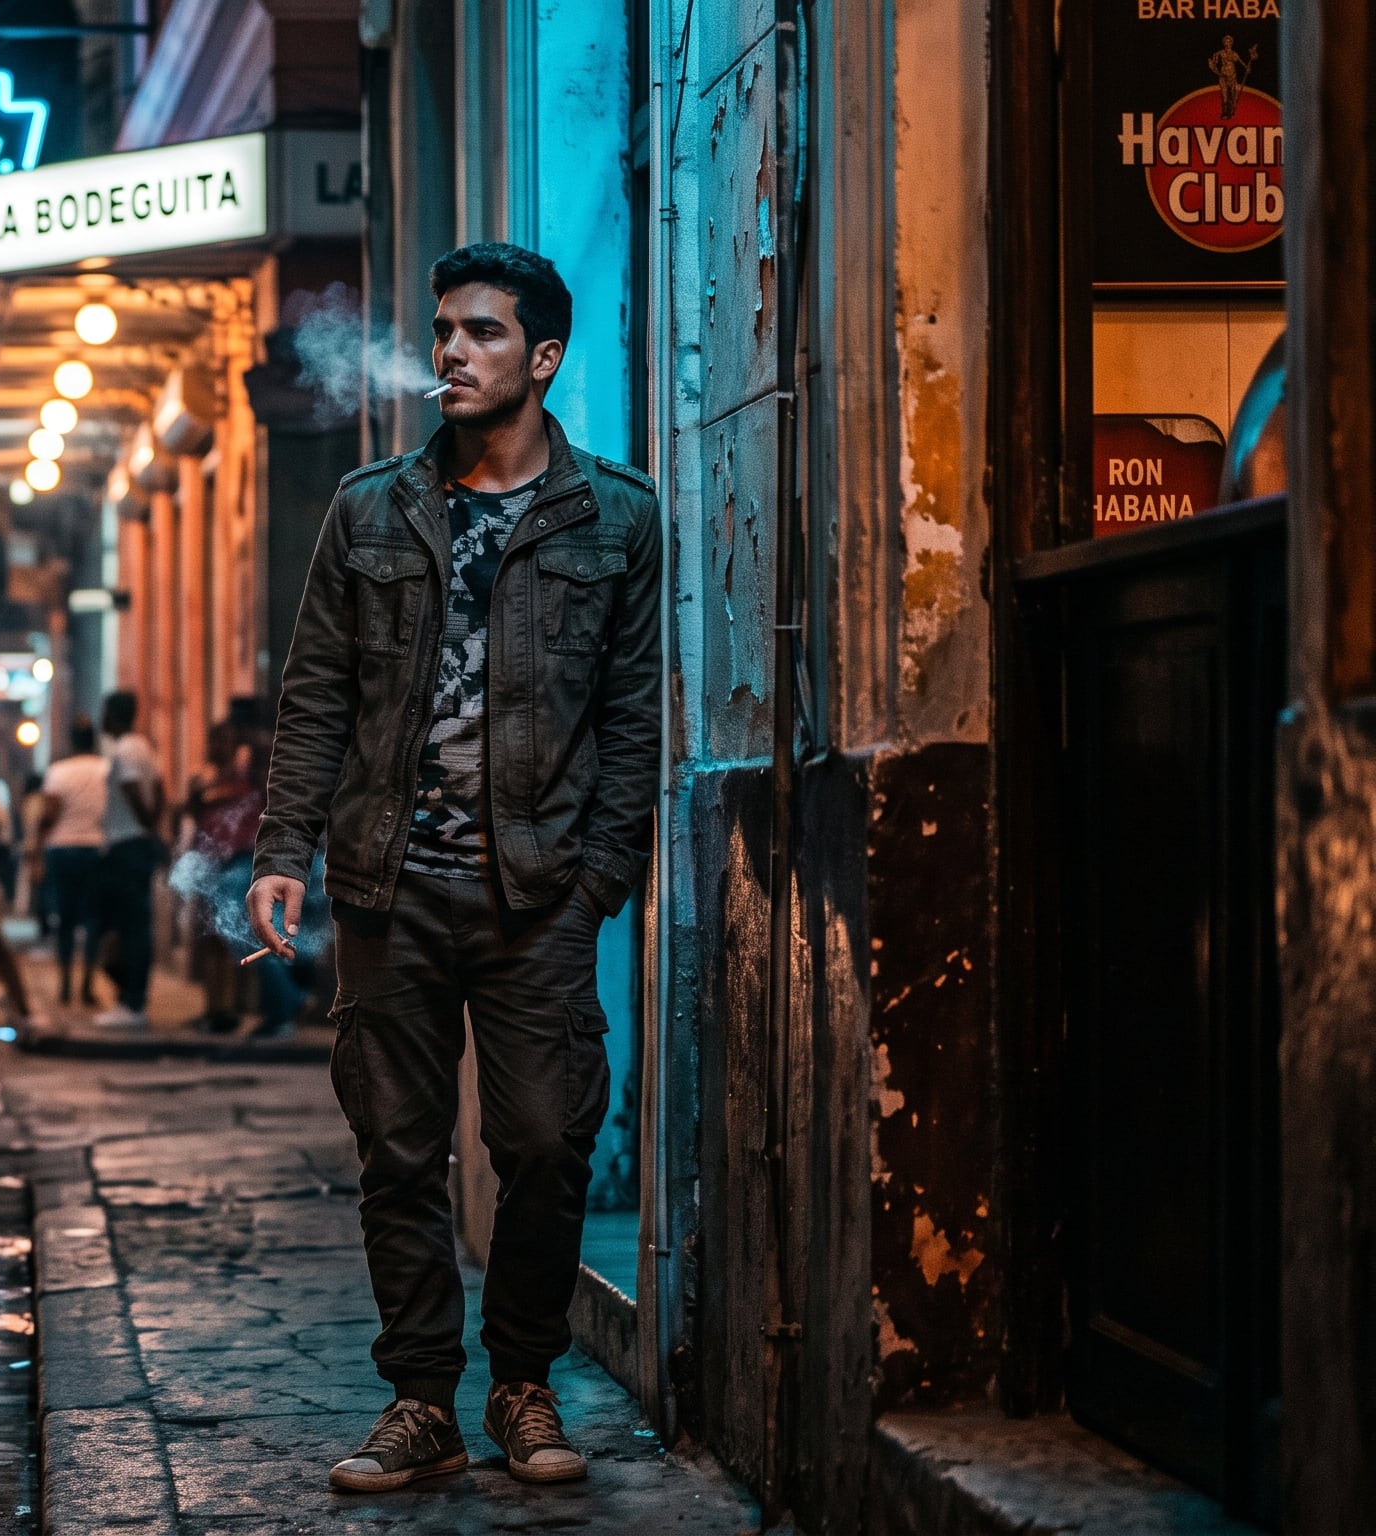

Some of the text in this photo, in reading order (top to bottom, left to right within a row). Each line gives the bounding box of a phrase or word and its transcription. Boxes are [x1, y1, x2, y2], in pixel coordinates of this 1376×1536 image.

[1138, 0, 1196, 19] BAR
[36, 171, 239, 235] BODEGUITA
[1169, 171, 1284, 223] Club
[1109, 458, 1163, 486] RON
